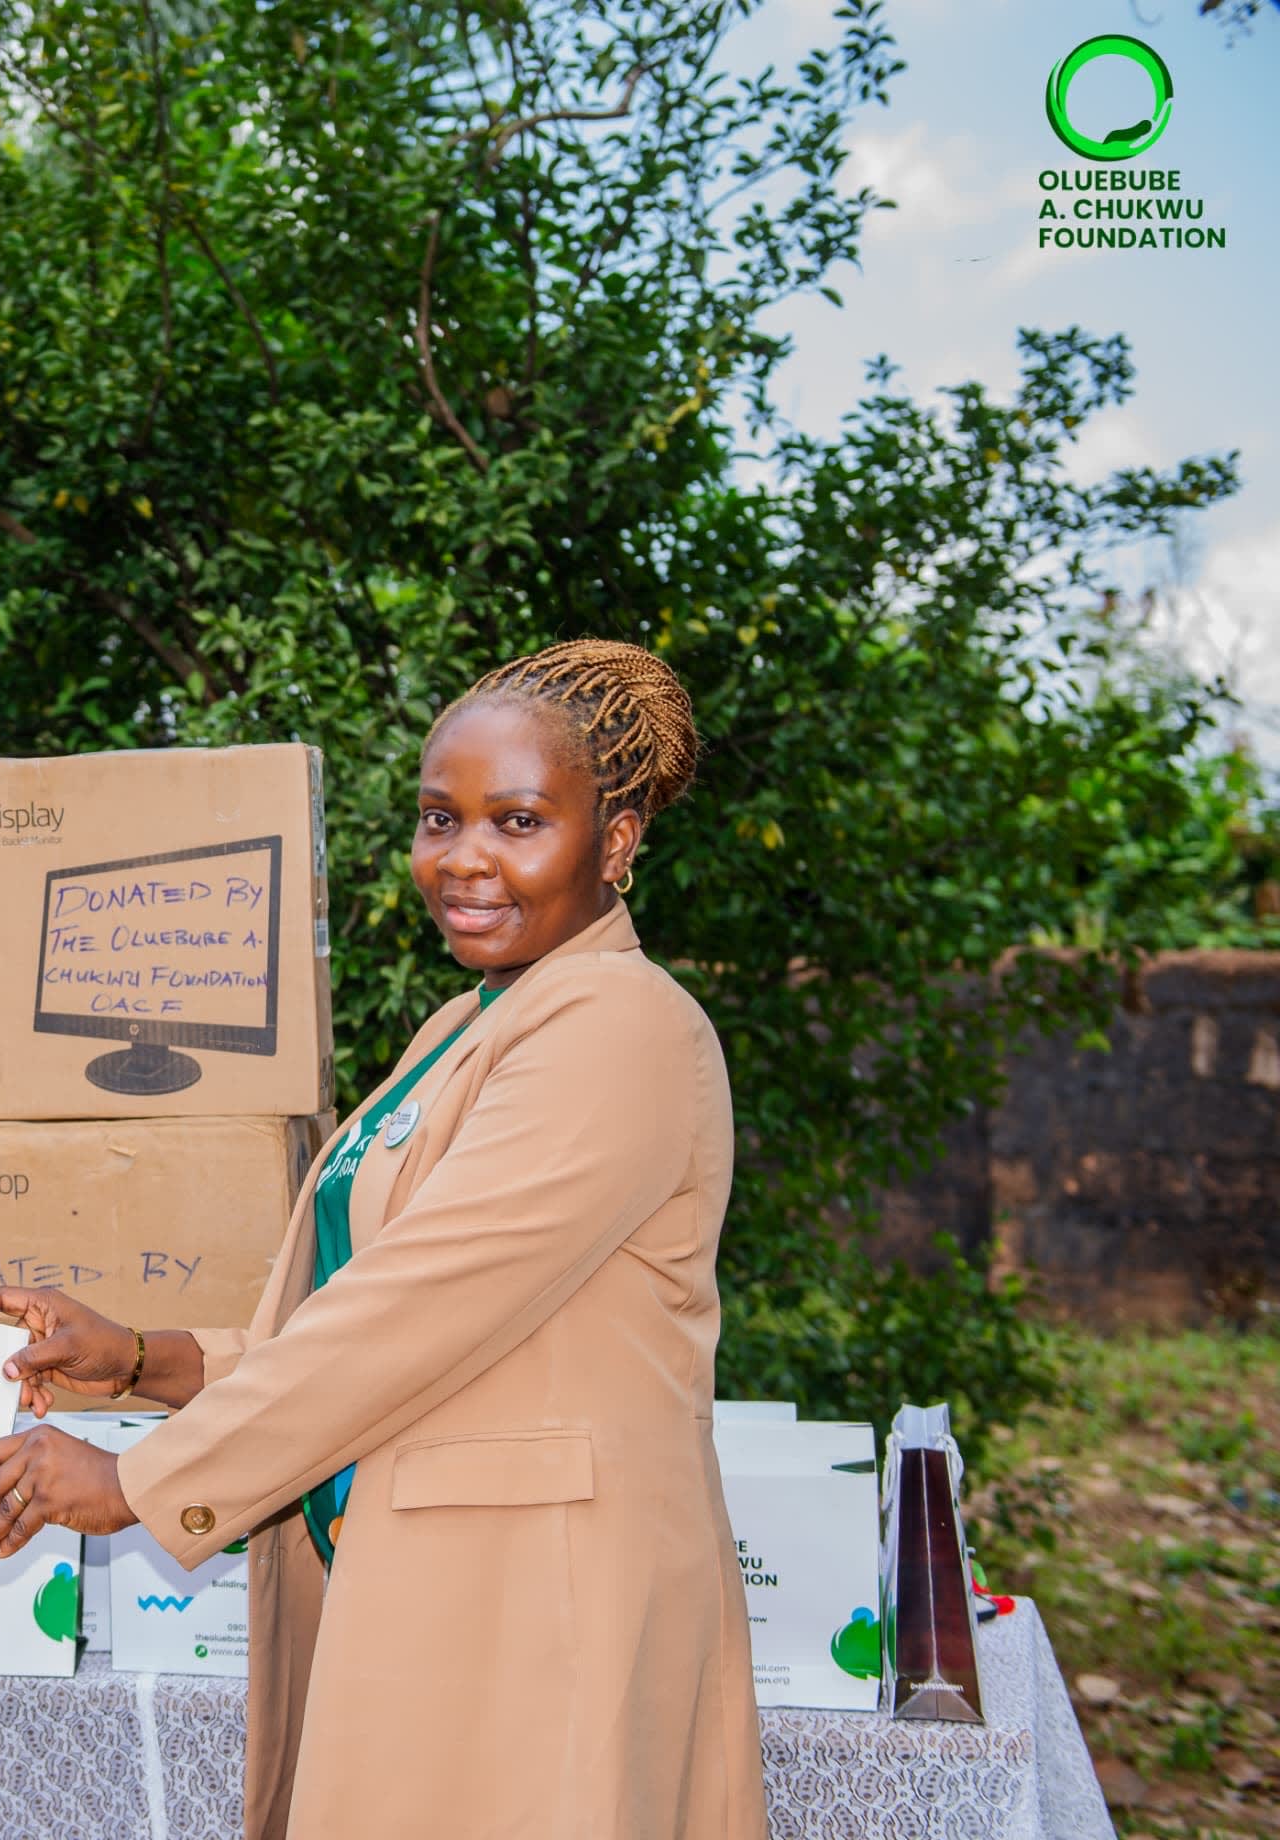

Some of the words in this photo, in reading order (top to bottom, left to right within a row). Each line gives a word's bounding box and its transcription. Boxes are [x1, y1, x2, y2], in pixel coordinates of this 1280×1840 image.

[54, 881, 212, 918] DONATED
[225, 876, 263, 910] BY
[49, 925, 102, 955] THE
[111, 925, 232, 952] OLUEBUBE
[243, 929, 263, 949] A.
[43, 967, 140, 987] CHUKWU
[140, 1251, 203, 1295] BY
[211, 1579, 248, 1591] Building
